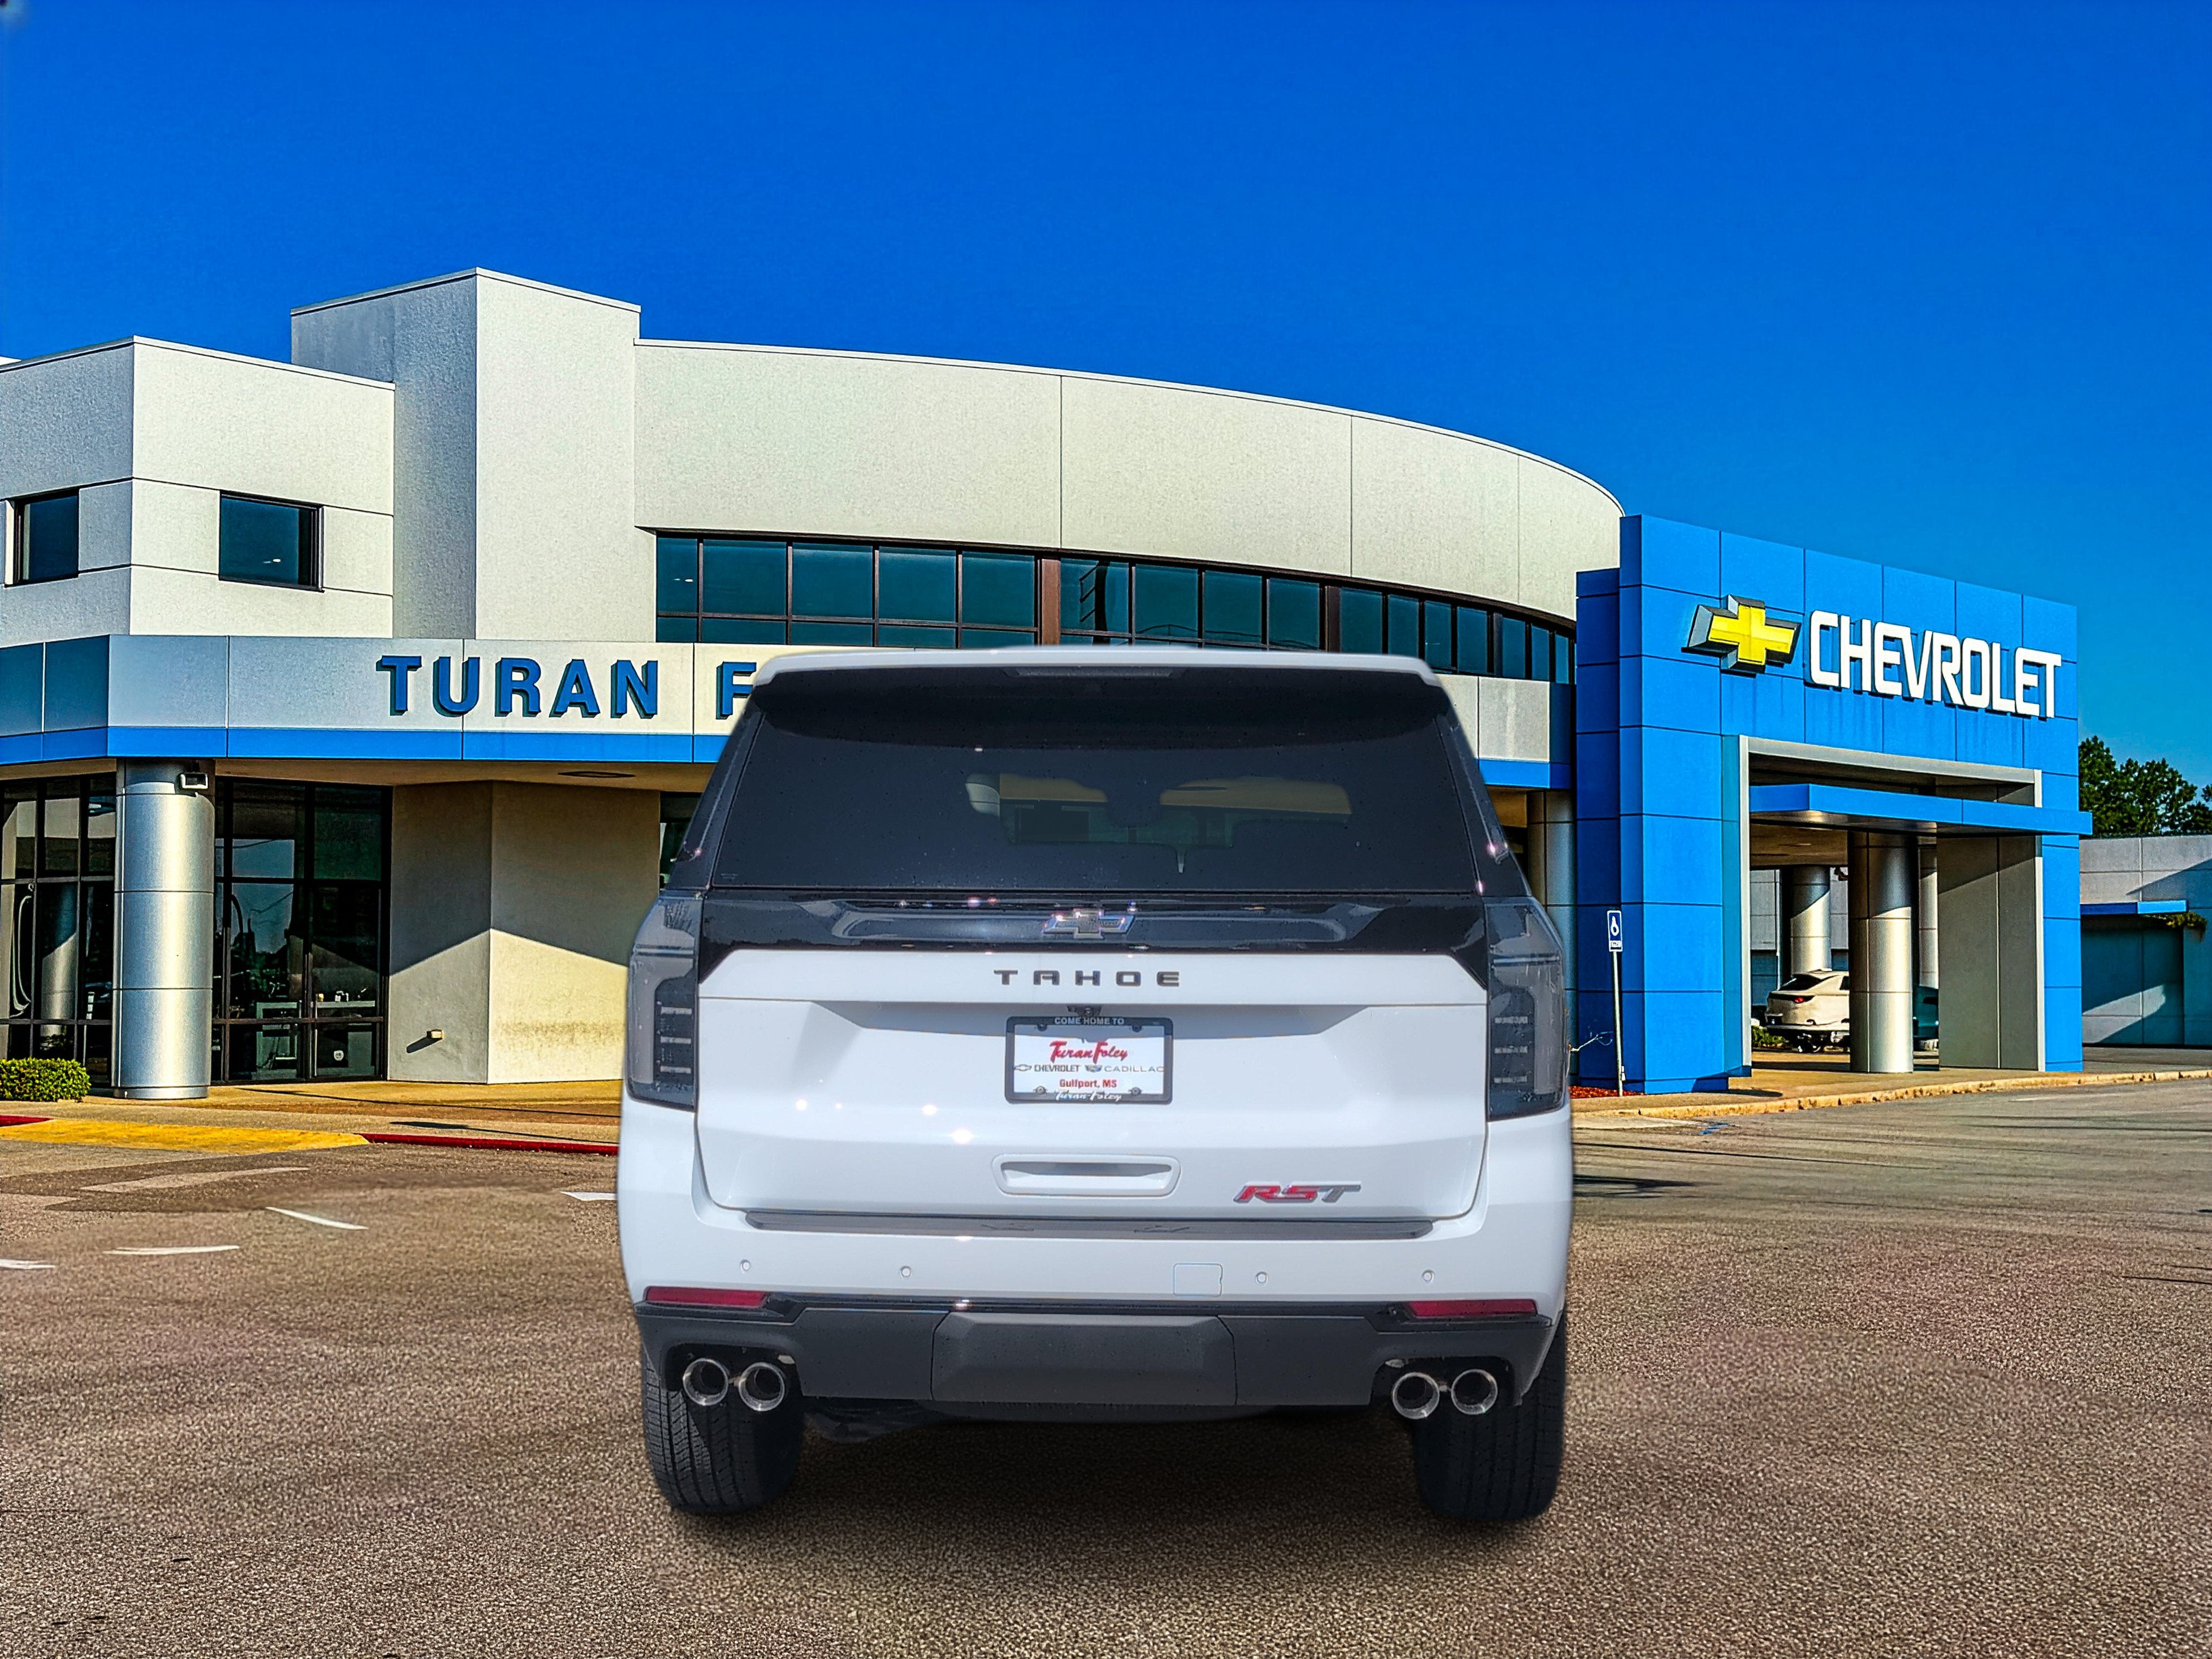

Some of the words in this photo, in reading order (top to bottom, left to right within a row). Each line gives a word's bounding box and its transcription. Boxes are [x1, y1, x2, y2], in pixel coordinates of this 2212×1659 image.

[1809, 610, 2062, 719] CHEVROLET
[376, 655, 658, 720] TURAN
[993, 969, 1180, 987] TAHOE
[1054, 1017, 1081, 1025] COME
[1083, 1017, 1110, 1025] HOME
[1049, 1040, 1094, 1064] Turan
[1092, 1041, 1128, 1064] Foley
[1033, 1064, 1079, 1072] CHEVROLET
[1104, 1065, 1165, 1073] CADILLAC
[1059, 1078, 1100, 1089] Gulfport,
[1102, 1079, 1117, 1088] MS
[1232, 1182, 1362, 1203] RST
